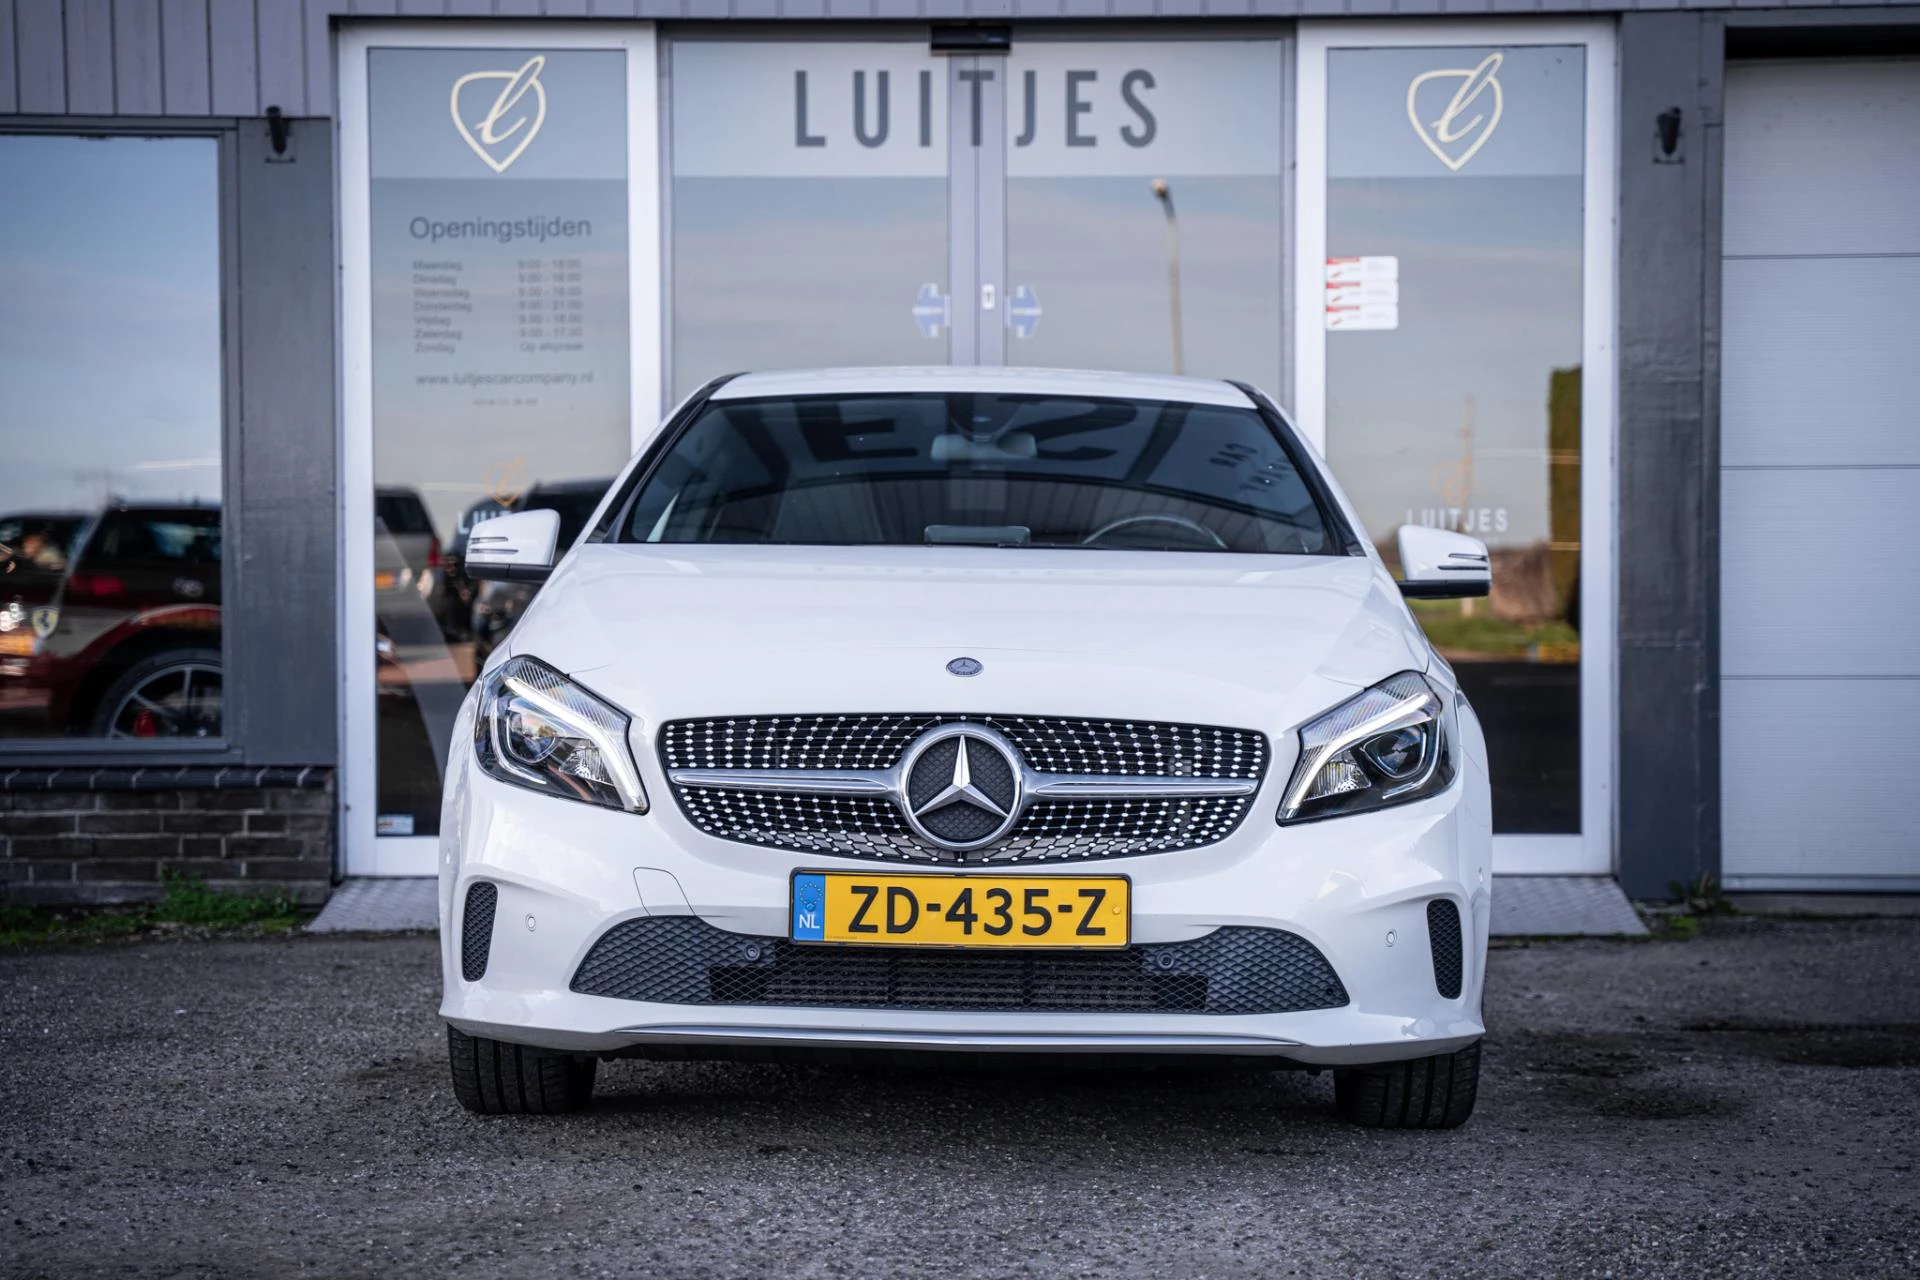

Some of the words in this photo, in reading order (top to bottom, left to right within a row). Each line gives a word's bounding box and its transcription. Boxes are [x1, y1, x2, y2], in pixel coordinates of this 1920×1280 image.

[795, 68, 1157, 148] LUITJES
[409, 216, 592, 244] Openingstijden
[1406, 508, 1508, 533] LUITJES
[798, 913, 820, 929] NL
[847, 885, 1106, 936] ZD-435-Z
